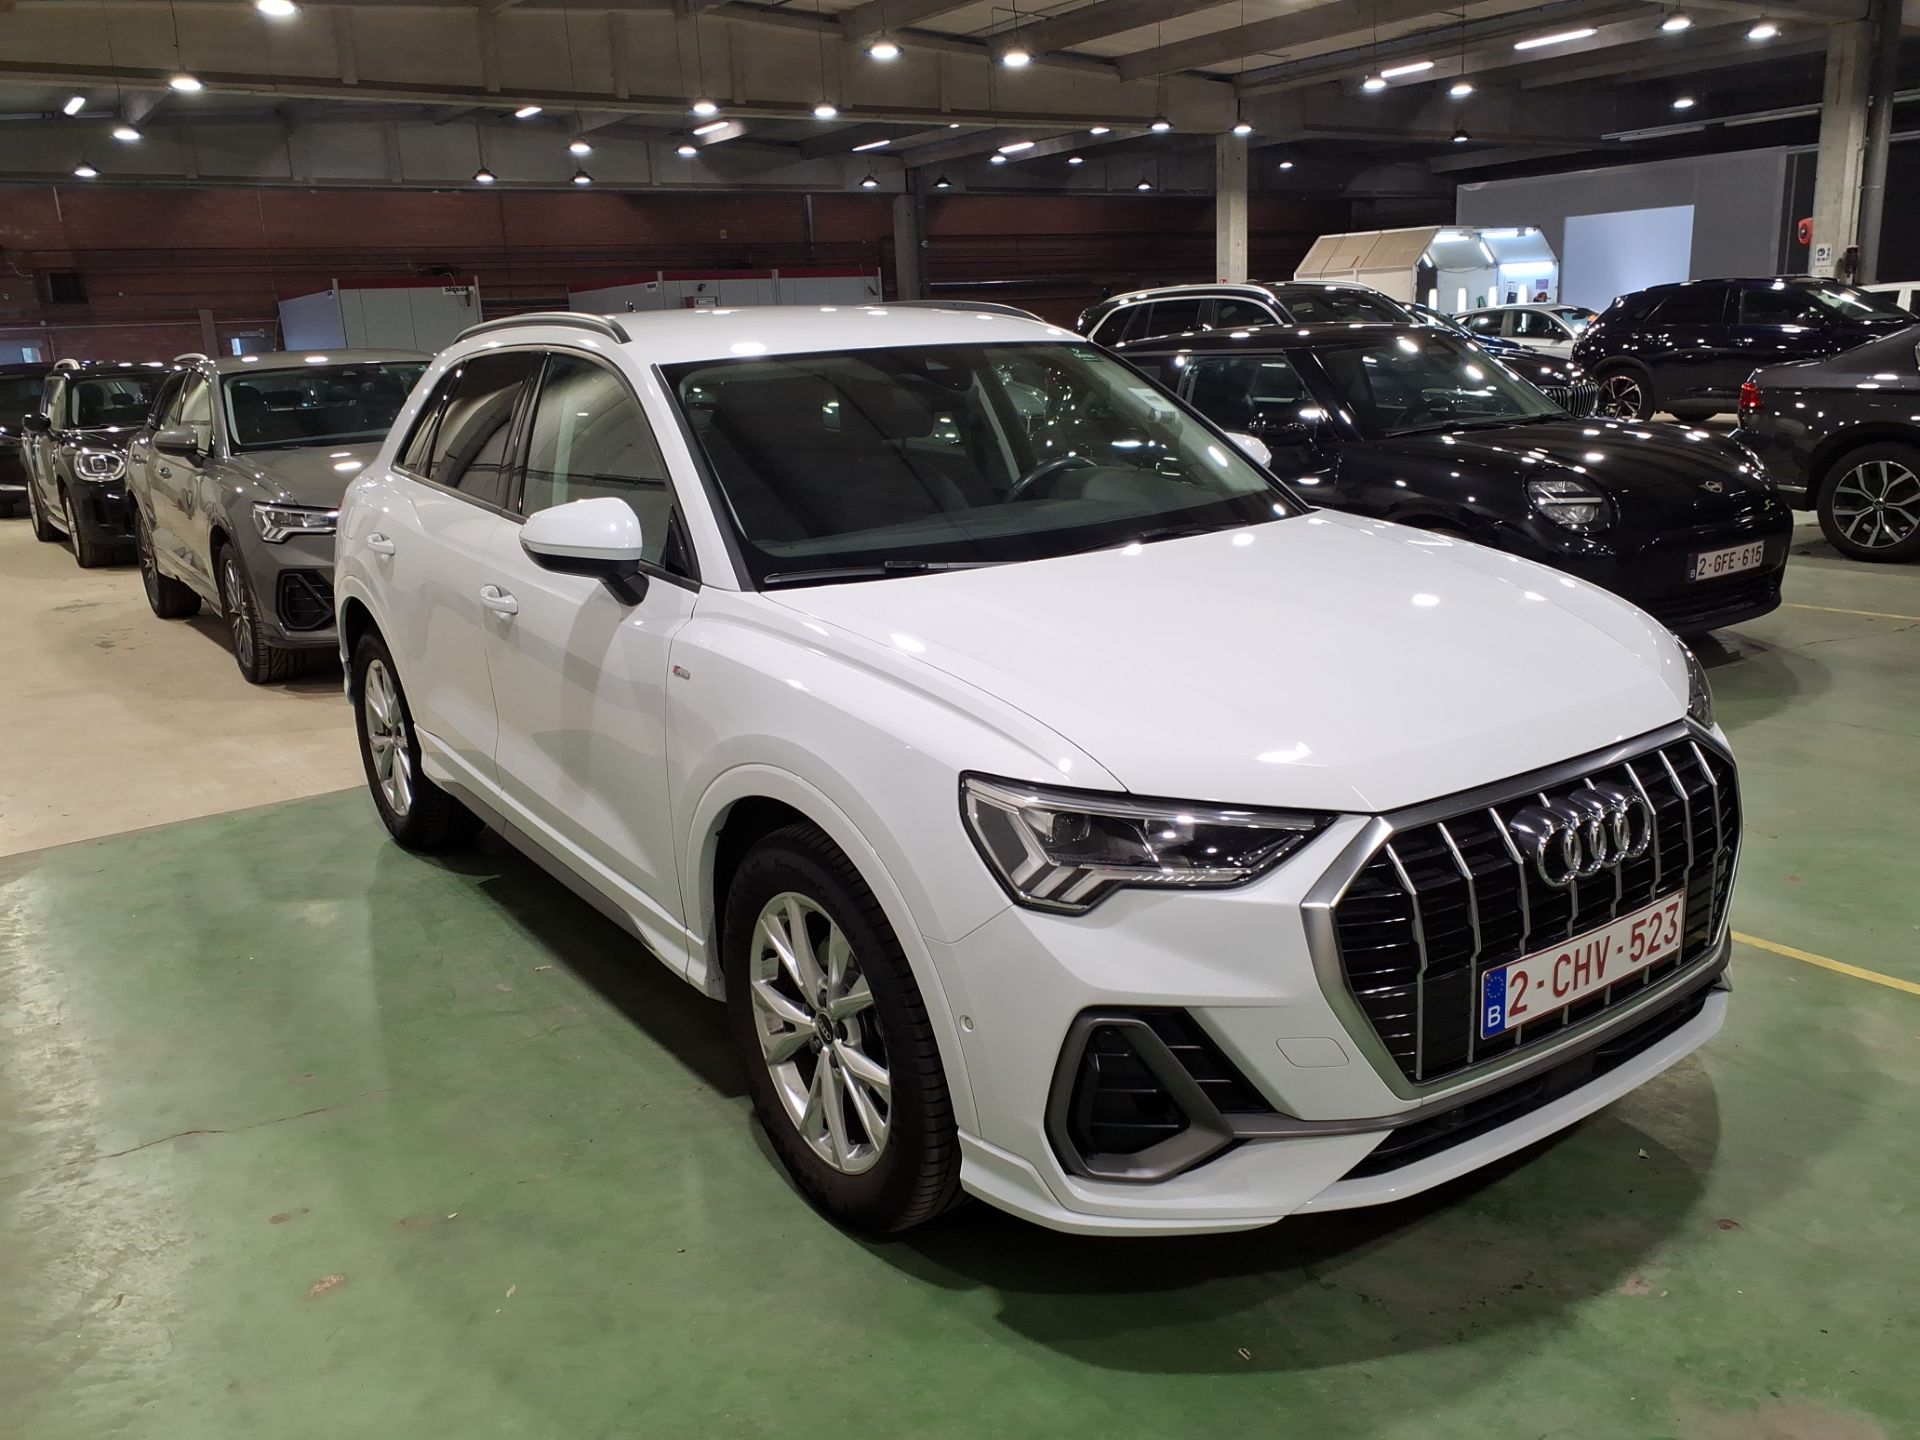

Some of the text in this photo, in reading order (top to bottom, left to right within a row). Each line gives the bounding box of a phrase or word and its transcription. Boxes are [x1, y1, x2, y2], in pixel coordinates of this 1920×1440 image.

[1697, 545, 1762, 576] 2-GFE-615
[1508, 902, 1680, 1018] 2-CHV-523
[1487, 1004, 1501, 1028] B
